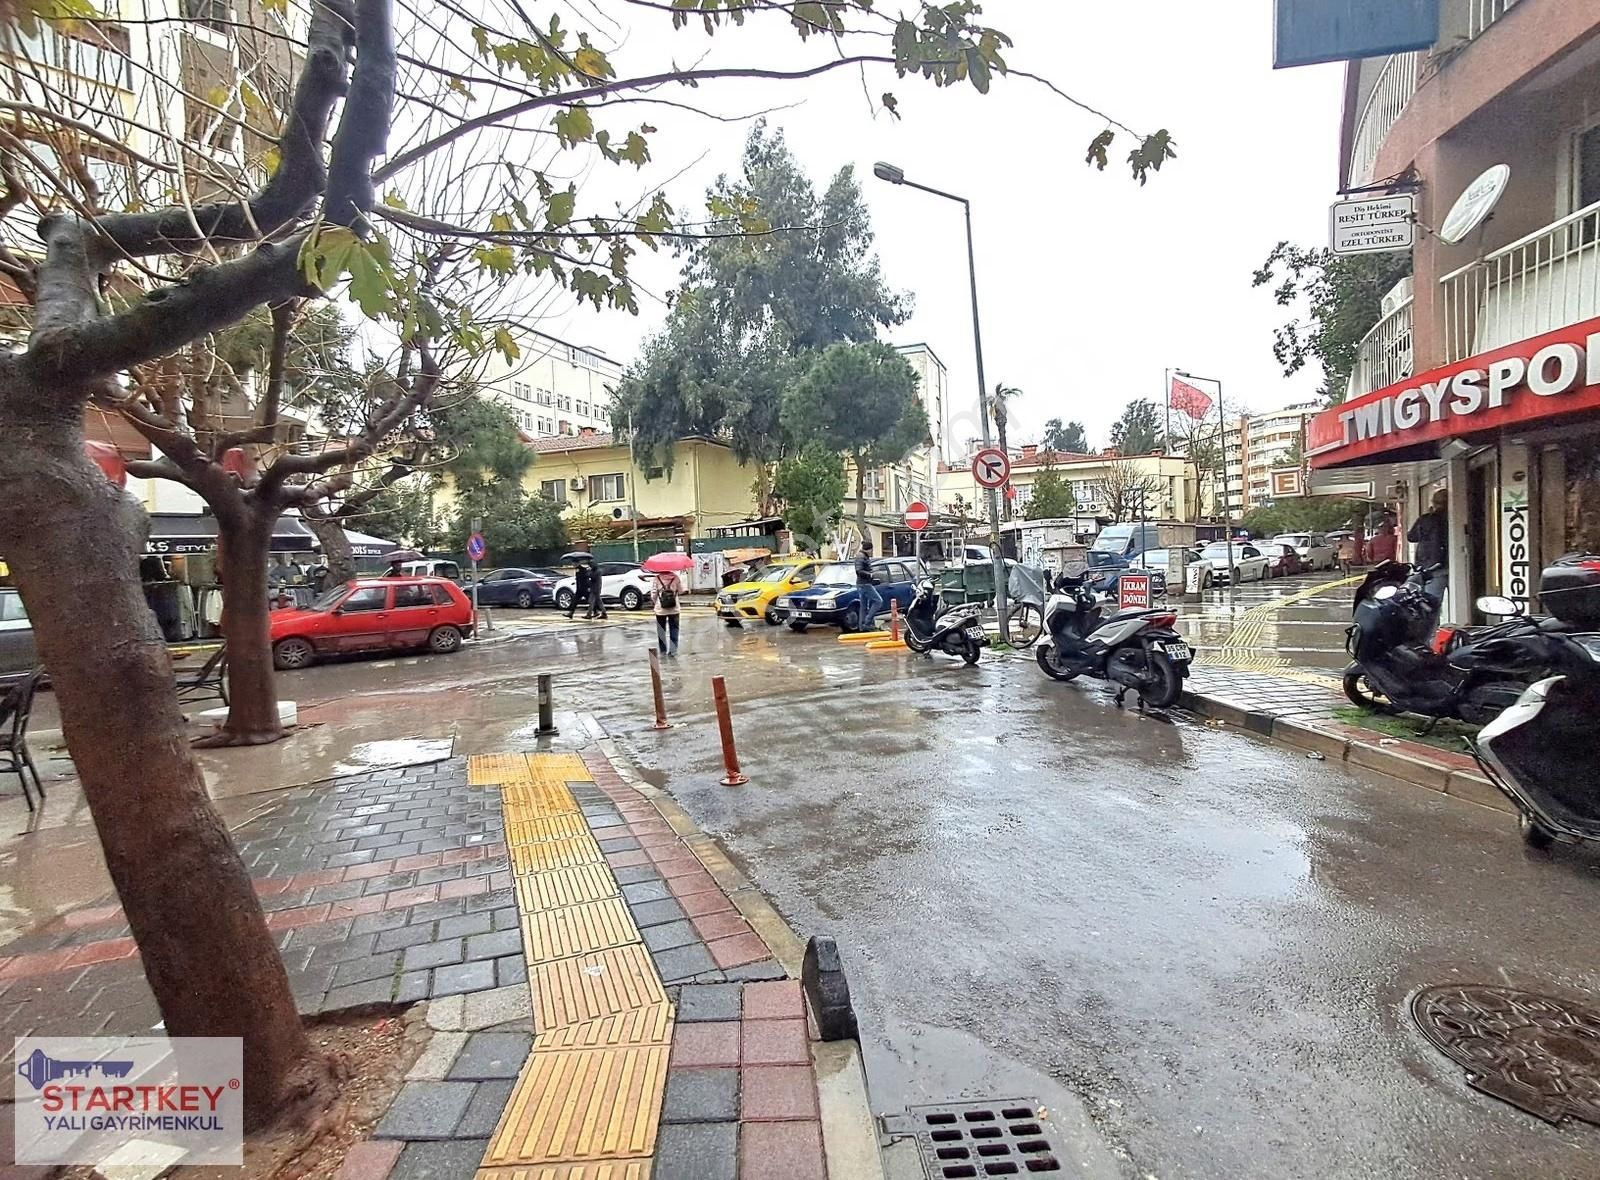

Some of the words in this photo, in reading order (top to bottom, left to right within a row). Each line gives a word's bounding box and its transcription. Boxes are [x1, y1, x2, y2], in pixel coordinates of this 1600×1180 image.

[1338, 213, 1366, 224] REŞİT
[1341, 238, 1364, 248] EZEL
[1365, 234, 1405, 246] TÜRKER
[1122, 579, 1147, 591] İKRAM
[1122, 592, 1147, 605] DÖNER
